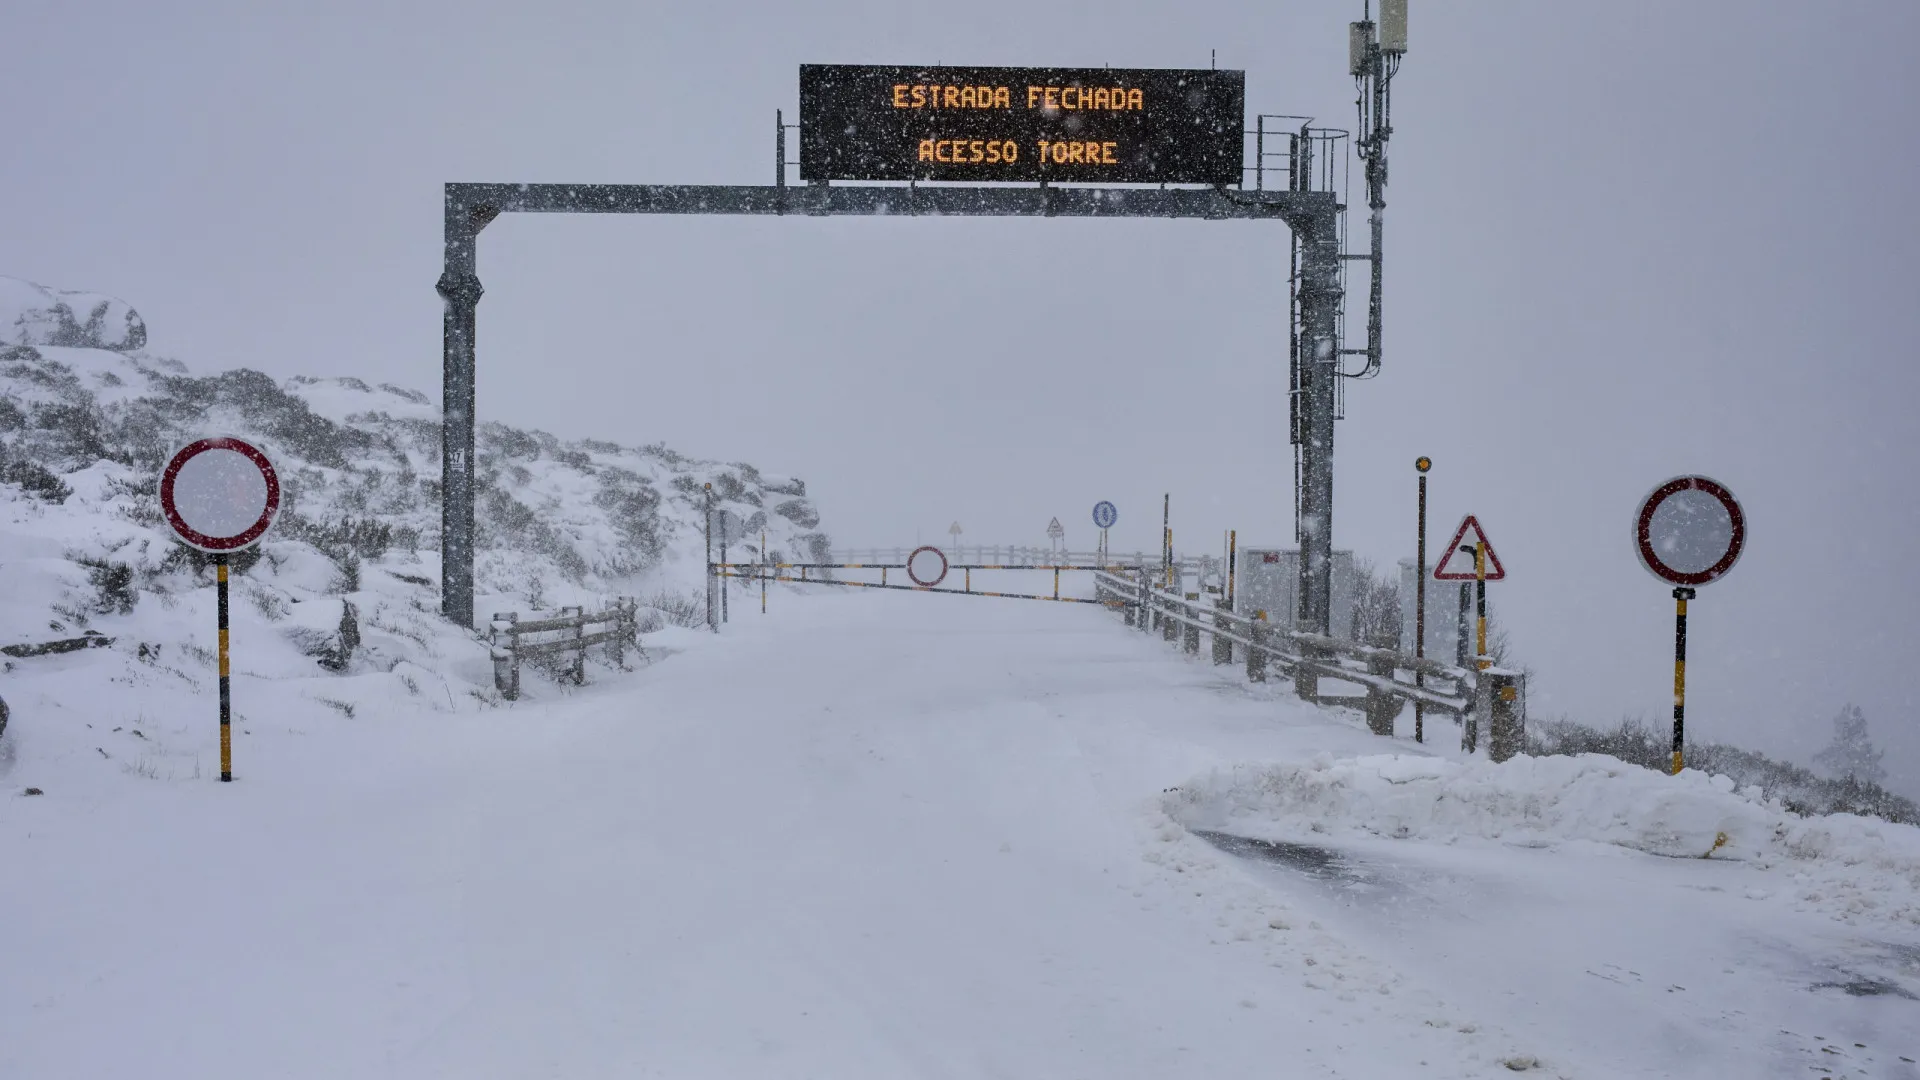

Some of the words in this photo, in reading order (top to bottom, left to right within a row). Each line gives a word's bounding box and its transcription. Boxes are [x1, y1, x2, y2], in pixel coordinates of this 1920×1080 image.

[893, 85, 1010, 109] ESTRADA
[1028, 86, 1143, 110] FECHADA
[918, 140, 1017, 163] ACESSO
[1037, 141, 1117, 164] TORRE
